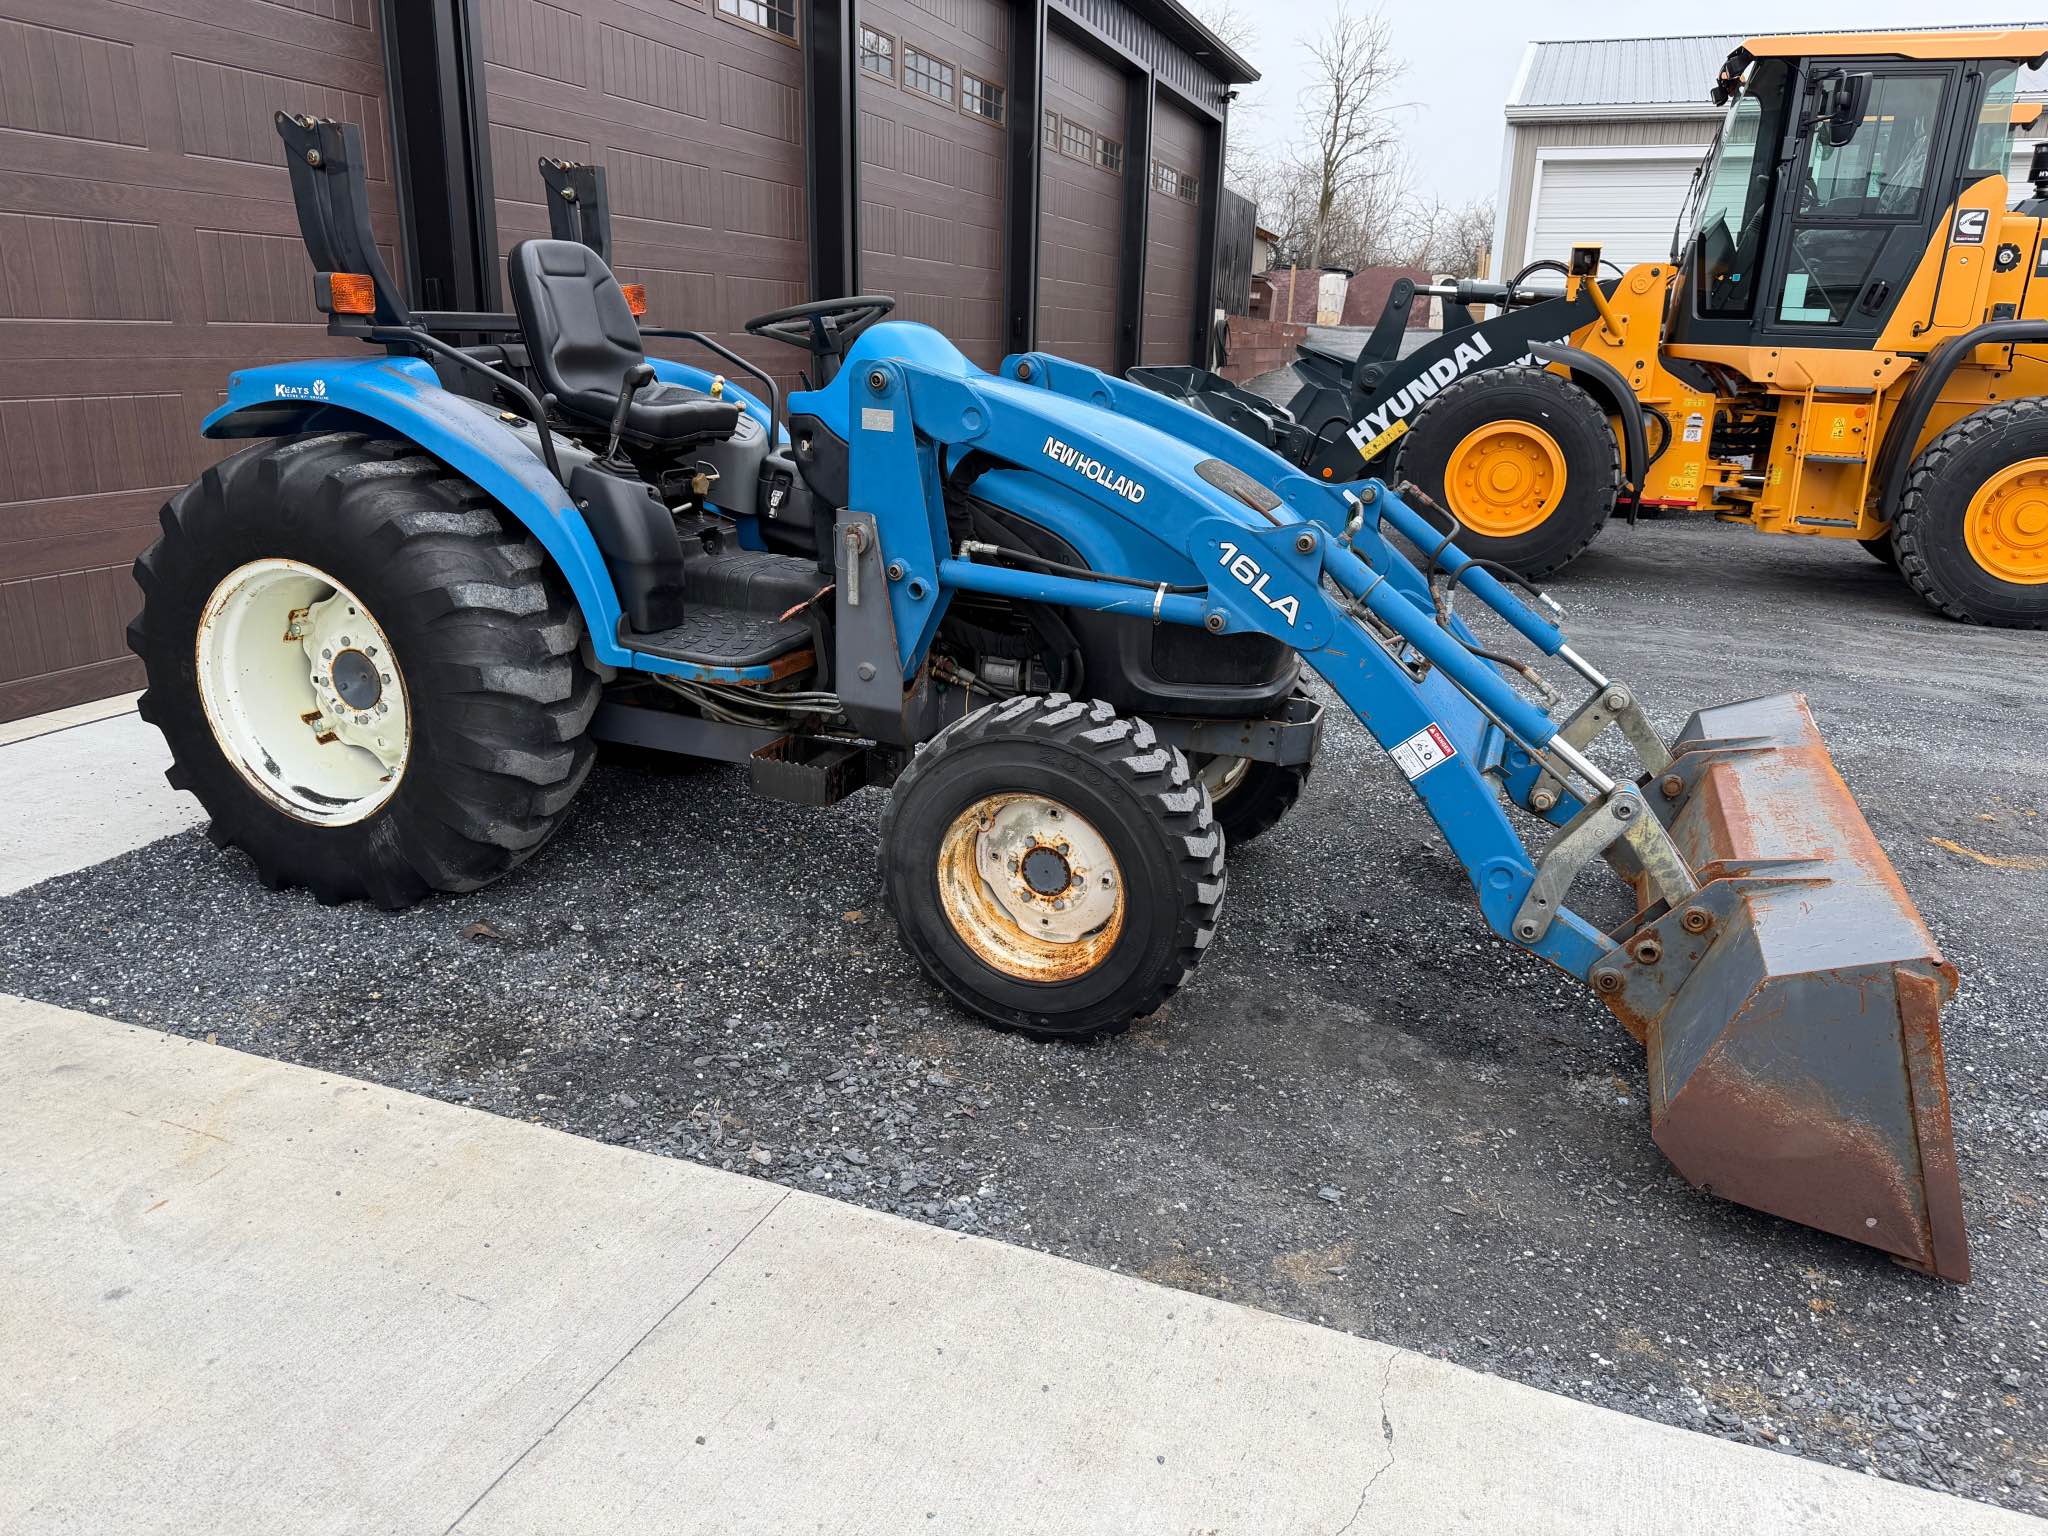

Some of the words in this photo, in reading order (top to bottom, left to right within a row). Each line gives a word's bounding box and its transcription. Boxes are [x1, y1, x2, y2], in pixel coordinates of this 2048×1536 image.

[1346, 331, 1493, 450] HYUNDAI
[1042, 436, 1079, 467] NEW
[1074, 453, 1146, 504] HOLLAND
[1218, 541, 1300, 628] 16LA
